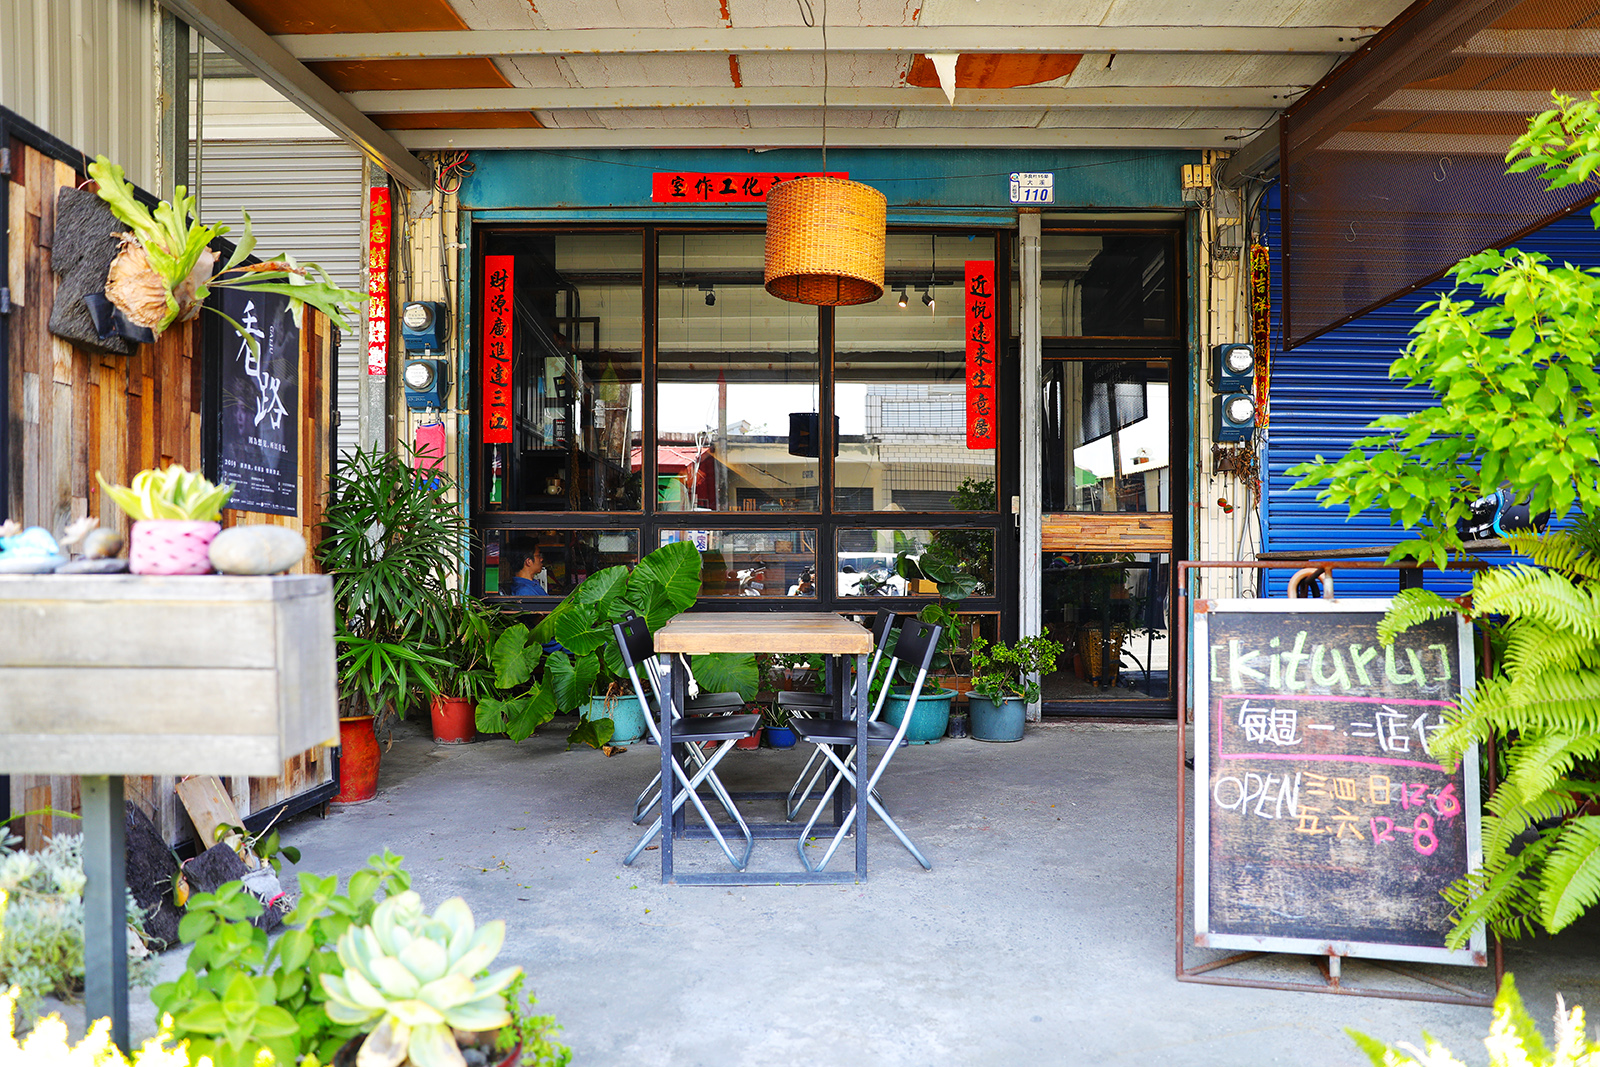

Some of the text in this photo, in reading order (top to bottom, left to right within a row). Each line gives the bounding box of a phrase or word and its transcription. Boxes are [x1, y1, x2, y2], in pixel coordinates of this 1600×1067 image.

[1025, 188, 1048, 201] 110
[489, 268, 510, 430] 財源廣進達三江
[1213, 772, 1301, 820] OPEN
[1400, 782, 1461, 818] 12-6
[1369, 812, 1439, 855] 12-8
